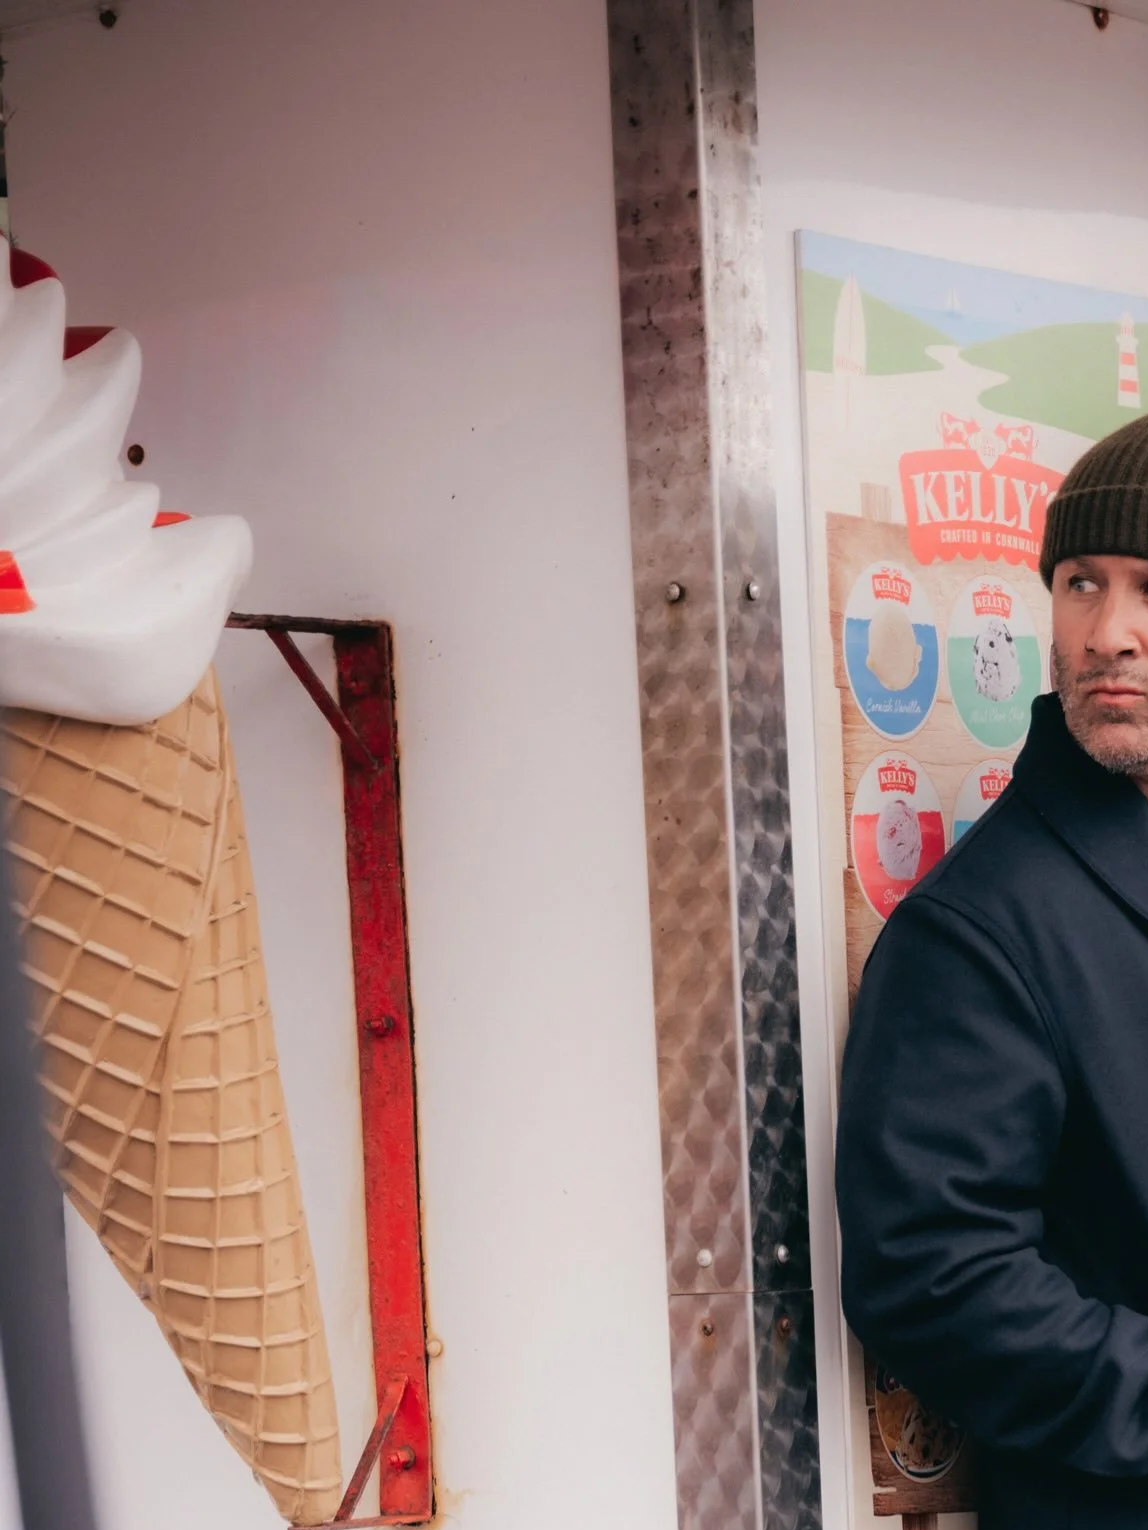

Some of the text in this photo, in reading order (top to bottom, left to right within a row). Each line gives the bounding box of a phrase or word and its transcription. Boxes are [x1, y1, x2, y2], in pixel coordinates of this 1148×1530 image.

[909, 470, 1056, 533] KELLY'
[940, 528, 1040, 556] CRAFTED IN CORNWALL
